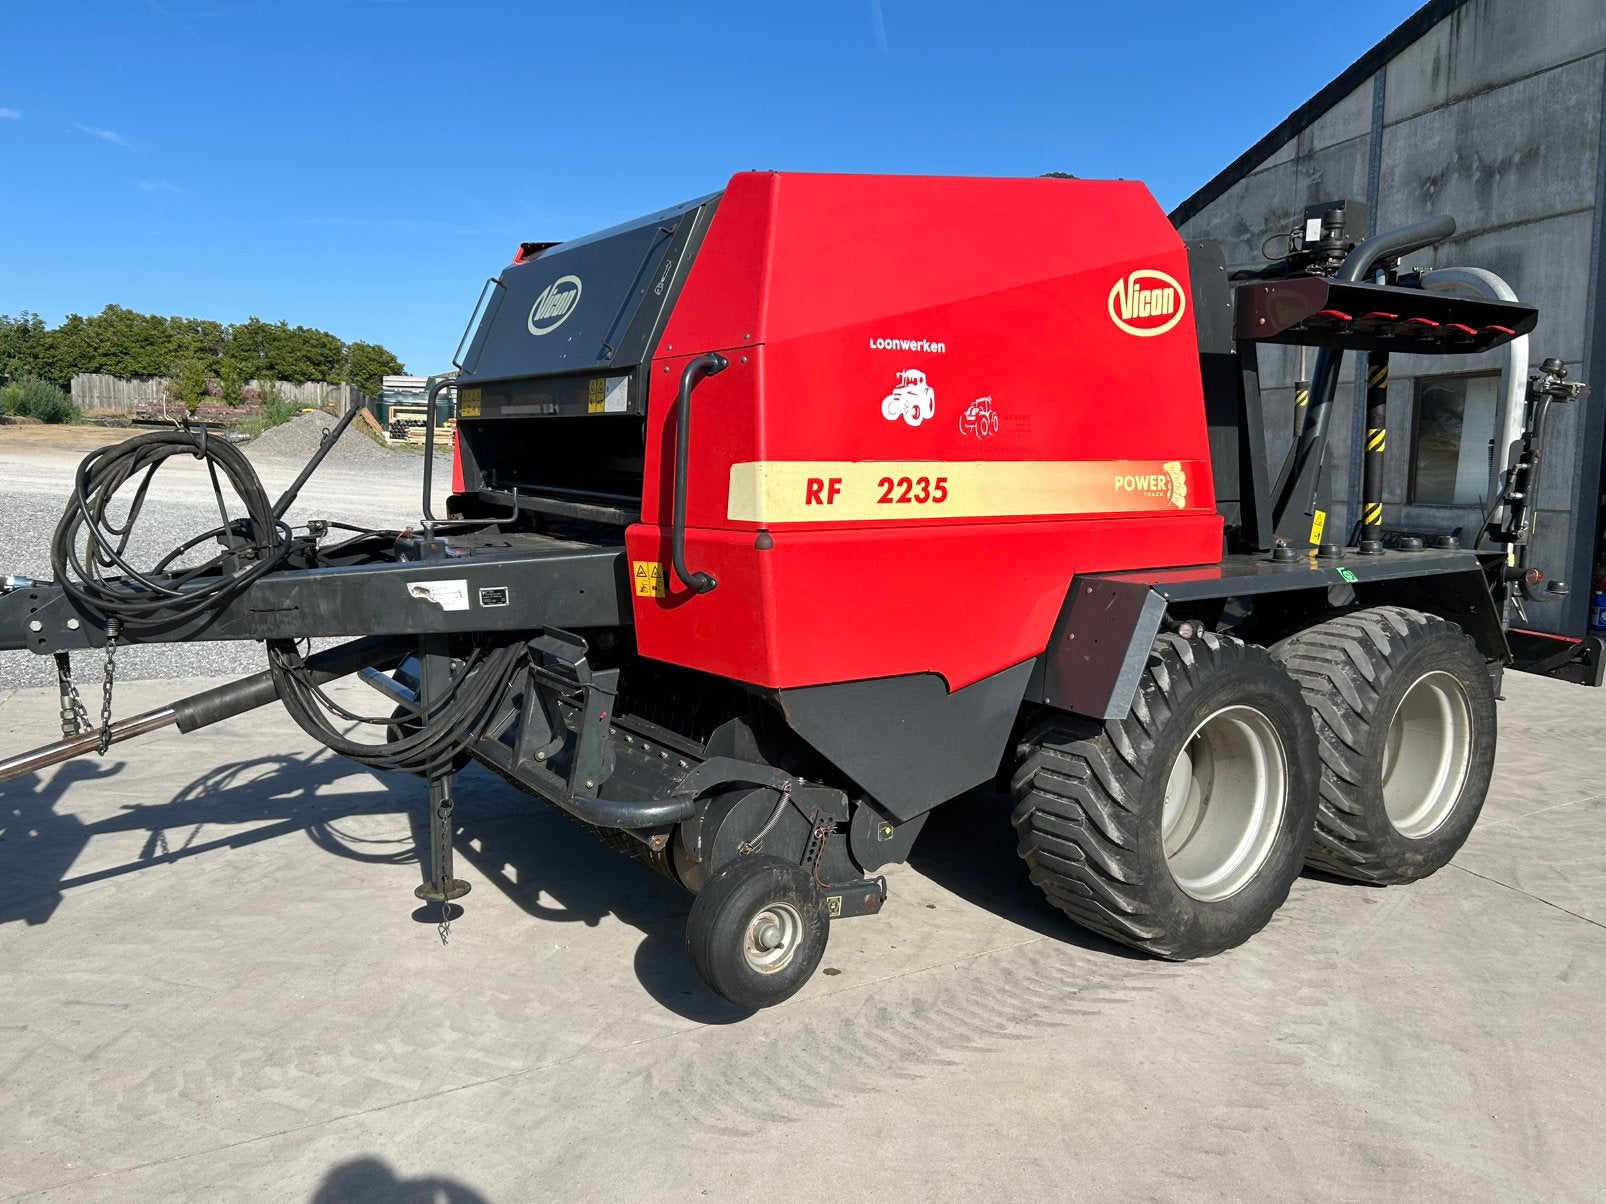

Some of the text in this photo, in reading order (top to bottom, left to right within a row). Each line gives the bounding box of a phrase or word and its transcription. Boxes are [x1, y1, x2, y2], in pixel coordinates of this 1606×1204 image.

[532, 280, 579, 323] Vicon
[1116, 271, 1177, 322] Vicon
[869, 338, 946, 353] Loonwerken
[805, 476, 948, 505] RF 2235
[1114, 474, 1166, 492] POWER
